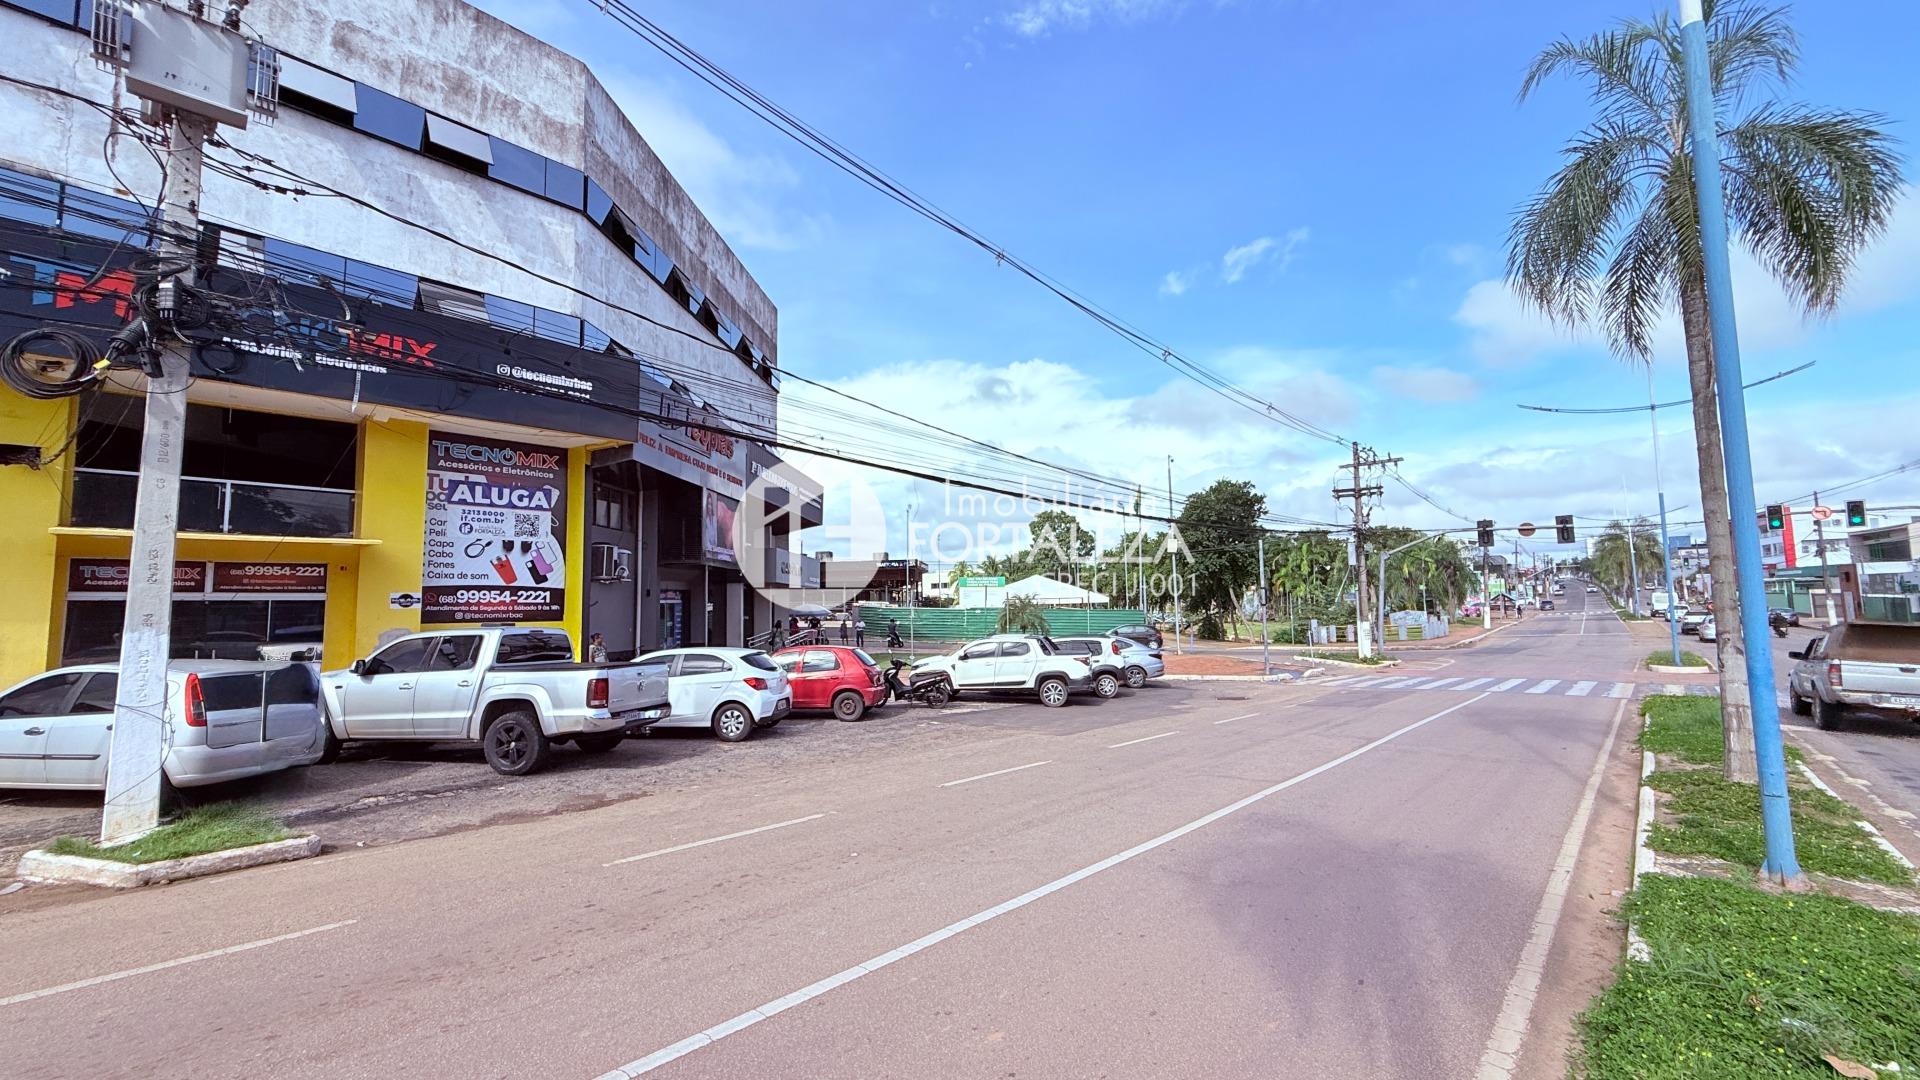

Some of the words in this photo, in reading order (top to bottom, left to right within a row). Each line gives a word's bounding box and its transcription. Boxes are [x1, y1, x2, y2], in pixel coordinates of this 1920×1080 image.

[432, 440, 560, 470] TECNOMIX
[438, 460, 493, 472] Acessórios
[503, 467, 554, 479] Eletrônicos
[451, 484, 550, 509] ALUGA
[461, 515, 505, 524] if.com.br
[428, 539, 454, 548] Capa
[428, 550, 454, 558] Cabo
[427, 560, 455, 569] Fones
[427, 571, 455, 580] Caixa
[457, 572, 468, 580] de
